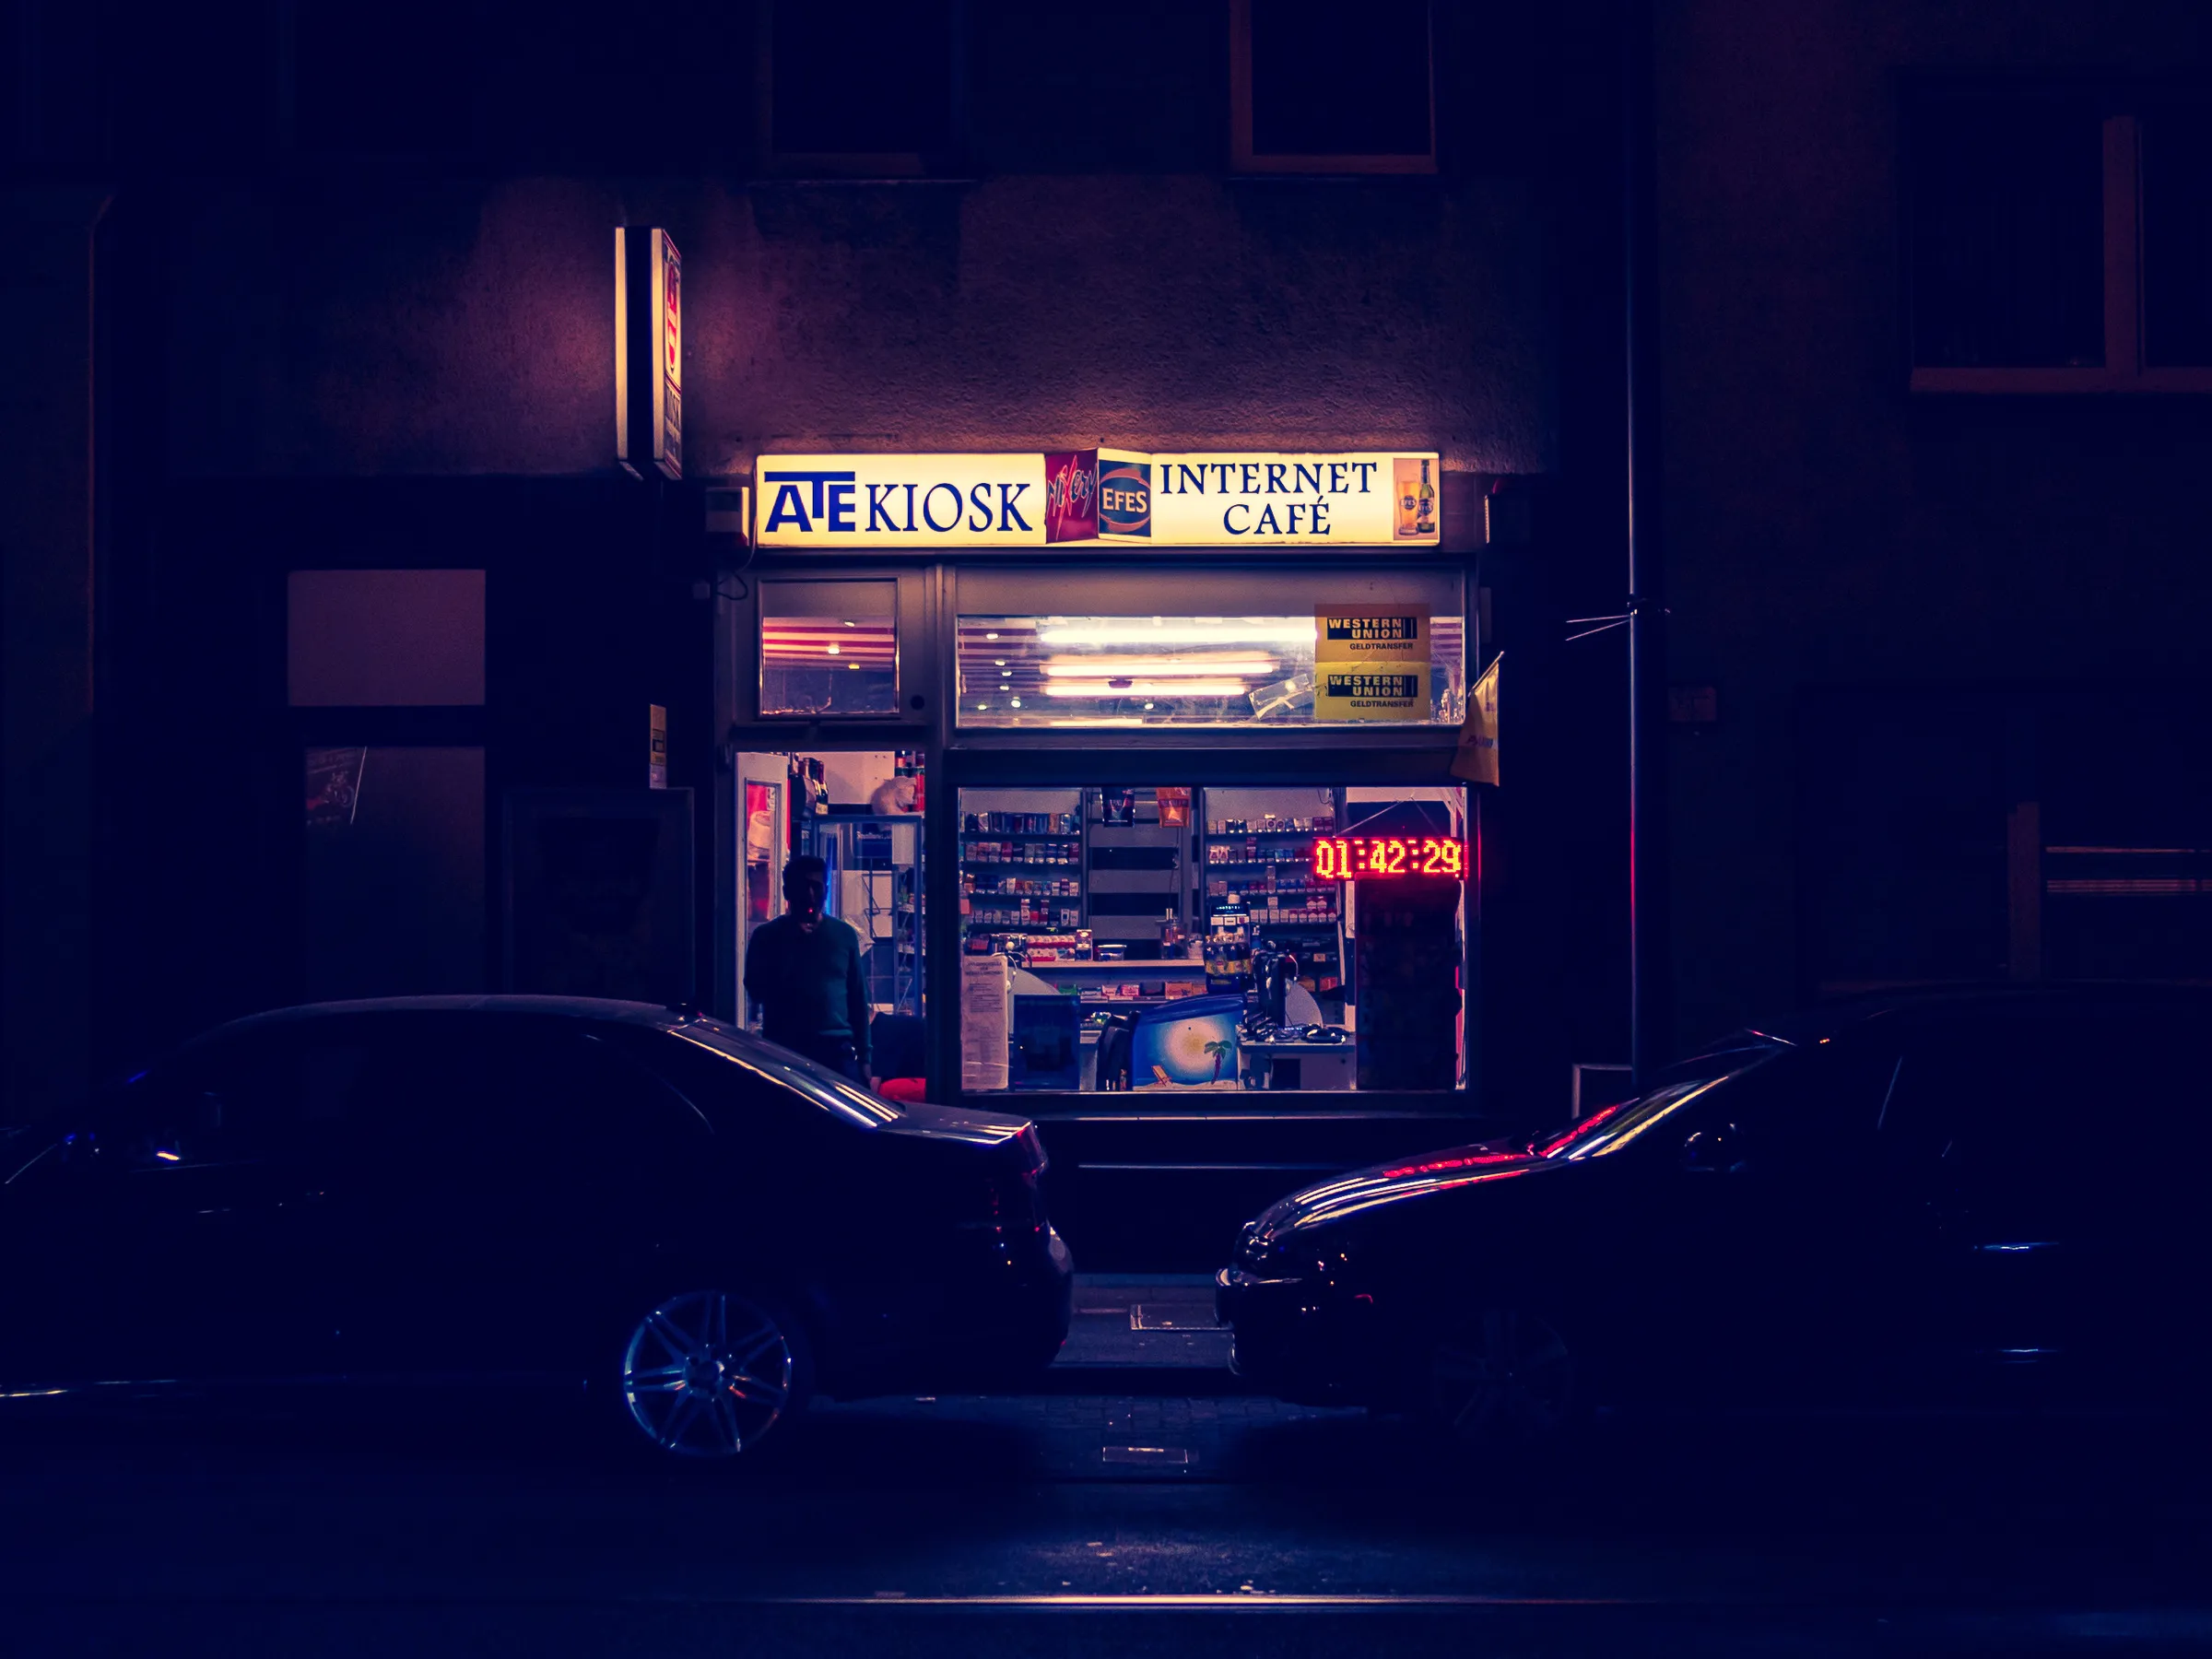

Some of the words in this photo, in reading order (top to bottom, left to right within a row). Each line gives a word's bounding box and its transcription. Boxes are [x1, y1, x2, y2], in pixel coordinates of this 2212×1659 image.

[1160, 462, 1377, 494] INTERNET
[765, 471, 855, 532] ATE
[865, 482, 1033, 532] KIOSK
[1102, 488, 1147, 513] EFES
[1223, 495, 1331, 535] CAFÉ
[1328, 618, 1402, 629] WESTERN
[1351, 629, 1402, 639] UNION
[1330, 676, 1403, 686] WESTERN
[1353, 687, 1403, 696] UNION
[1316, 840, 1462, 878] 01:42:29
